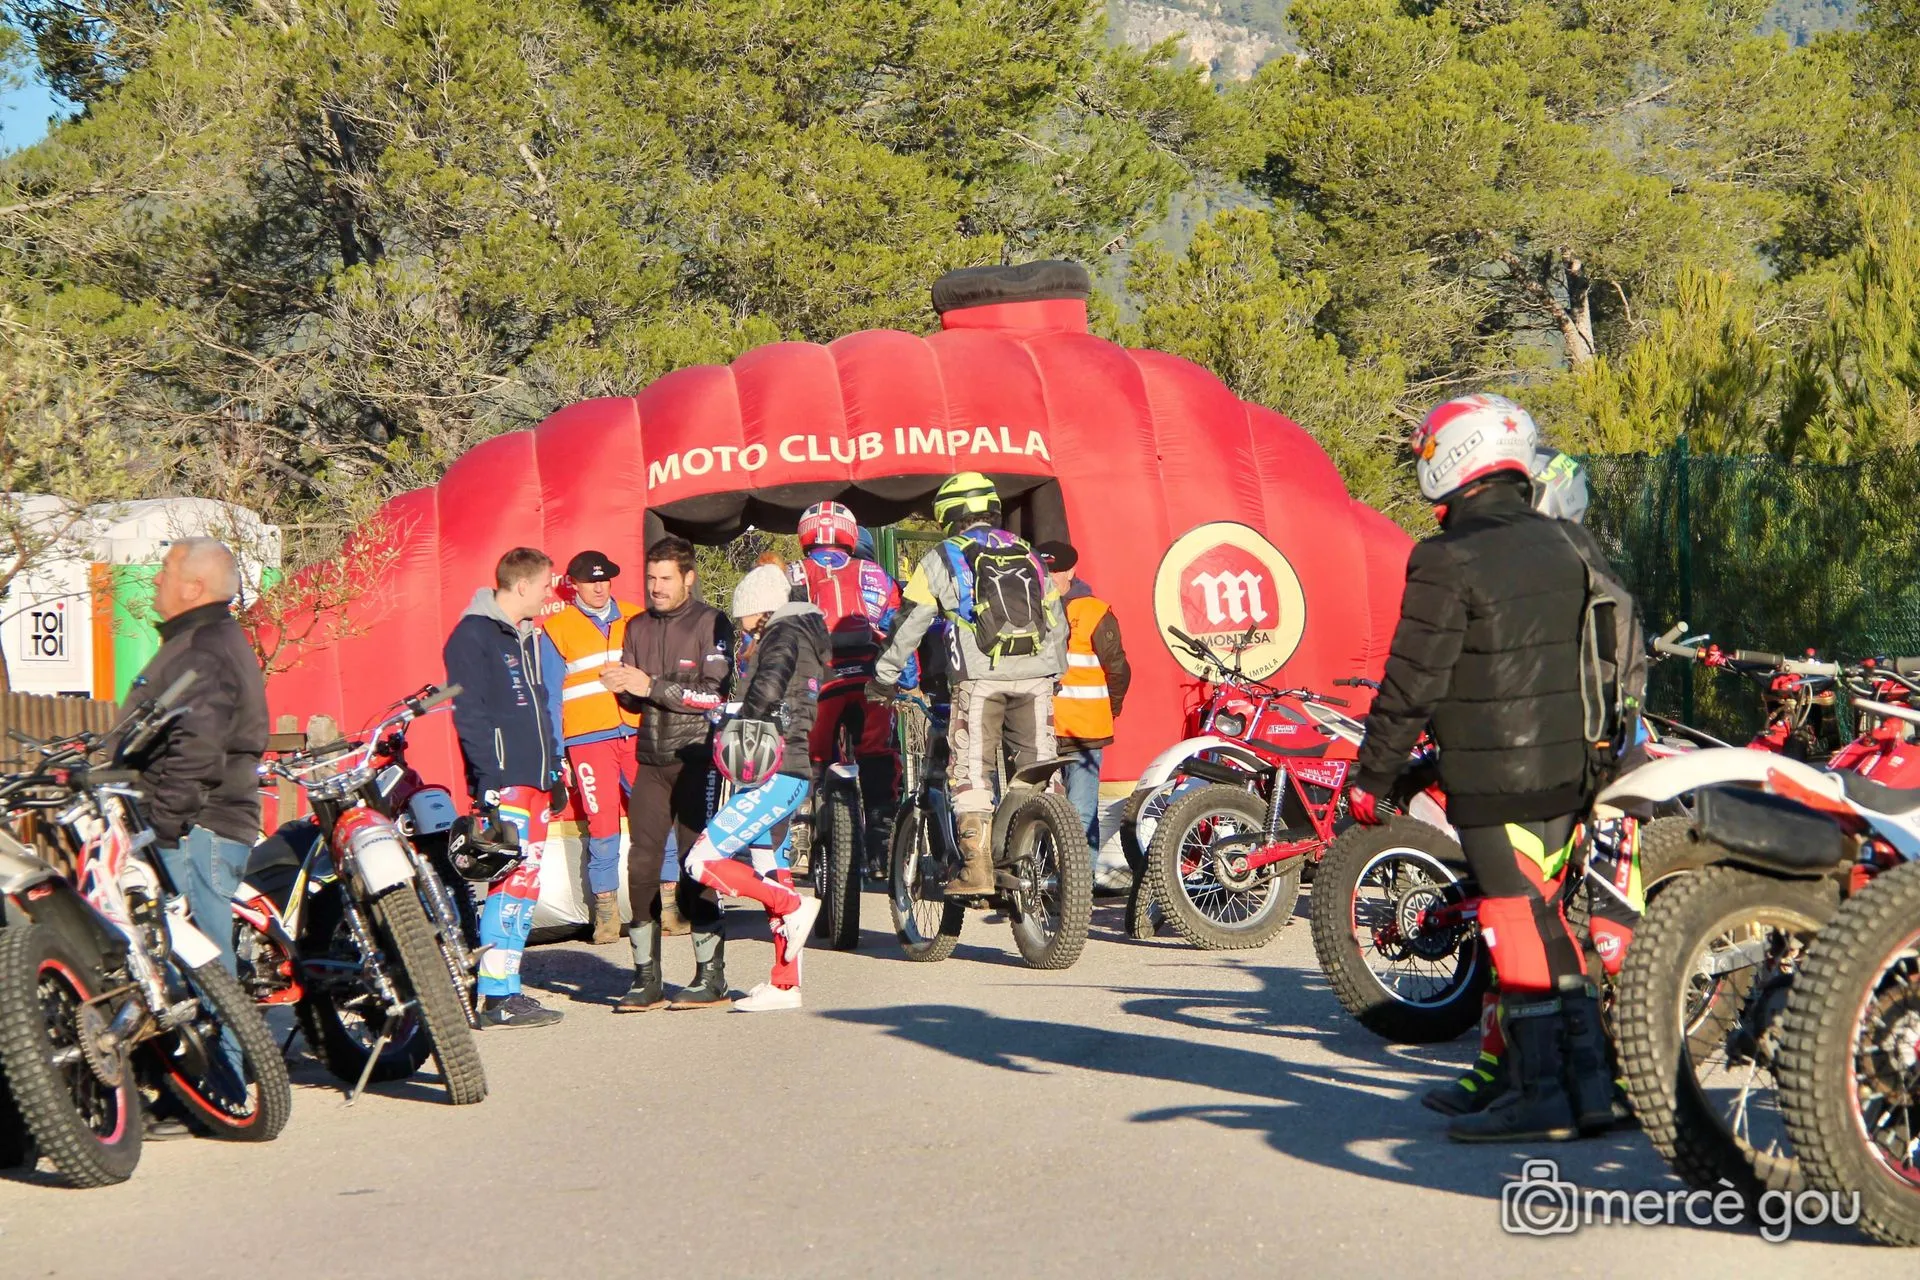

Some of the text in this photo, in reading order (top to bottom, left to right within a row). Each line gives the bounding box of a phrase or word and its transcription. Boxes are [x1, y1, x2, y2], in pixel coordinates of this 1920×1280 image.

[648, 426, 1051, 489] MOTO CLUB IMPALA
[31, 634, 63, 657] TOI
[1199, 631, 1271, 647] MONTSA
[1249, 657, 1279, 678] IMPALA
